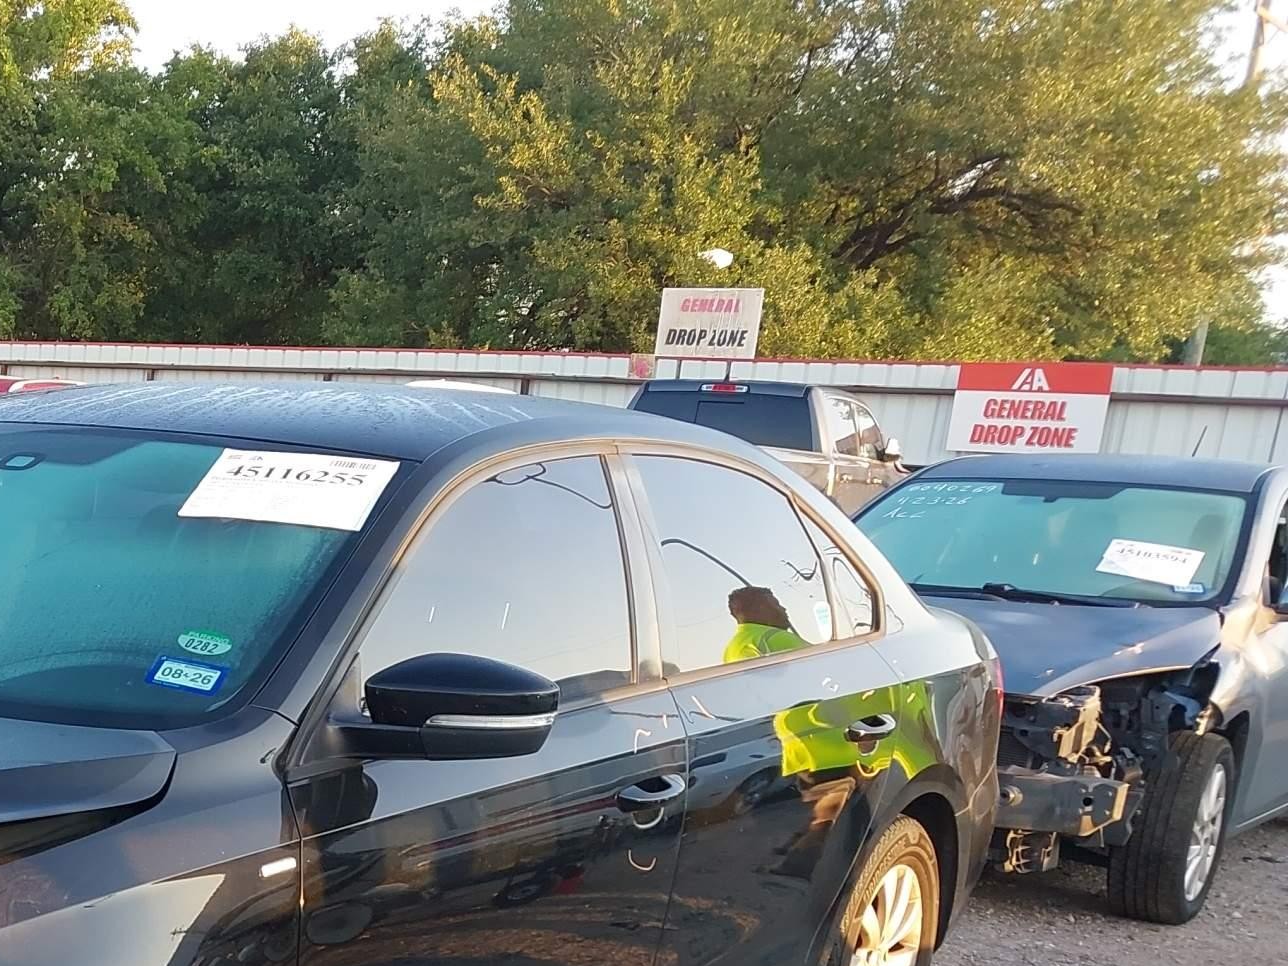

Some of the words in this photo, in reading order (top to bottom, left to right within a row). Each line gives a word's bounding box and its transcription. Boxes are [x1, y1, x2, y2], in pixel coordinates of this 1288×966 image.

[679, 297, 740, 314] GENERAL
[665, 328, 708, 347] DROP
[707, 329, 748, 348] ZONE
[983, 398, 1067, 421] GENERAL
[969, 423, 1025, 446] DROP
[1025, 426, 1078, 449] ZONE
[225, 464, 368, 487] 45116255
[184, 638, 219, 653] 0282
